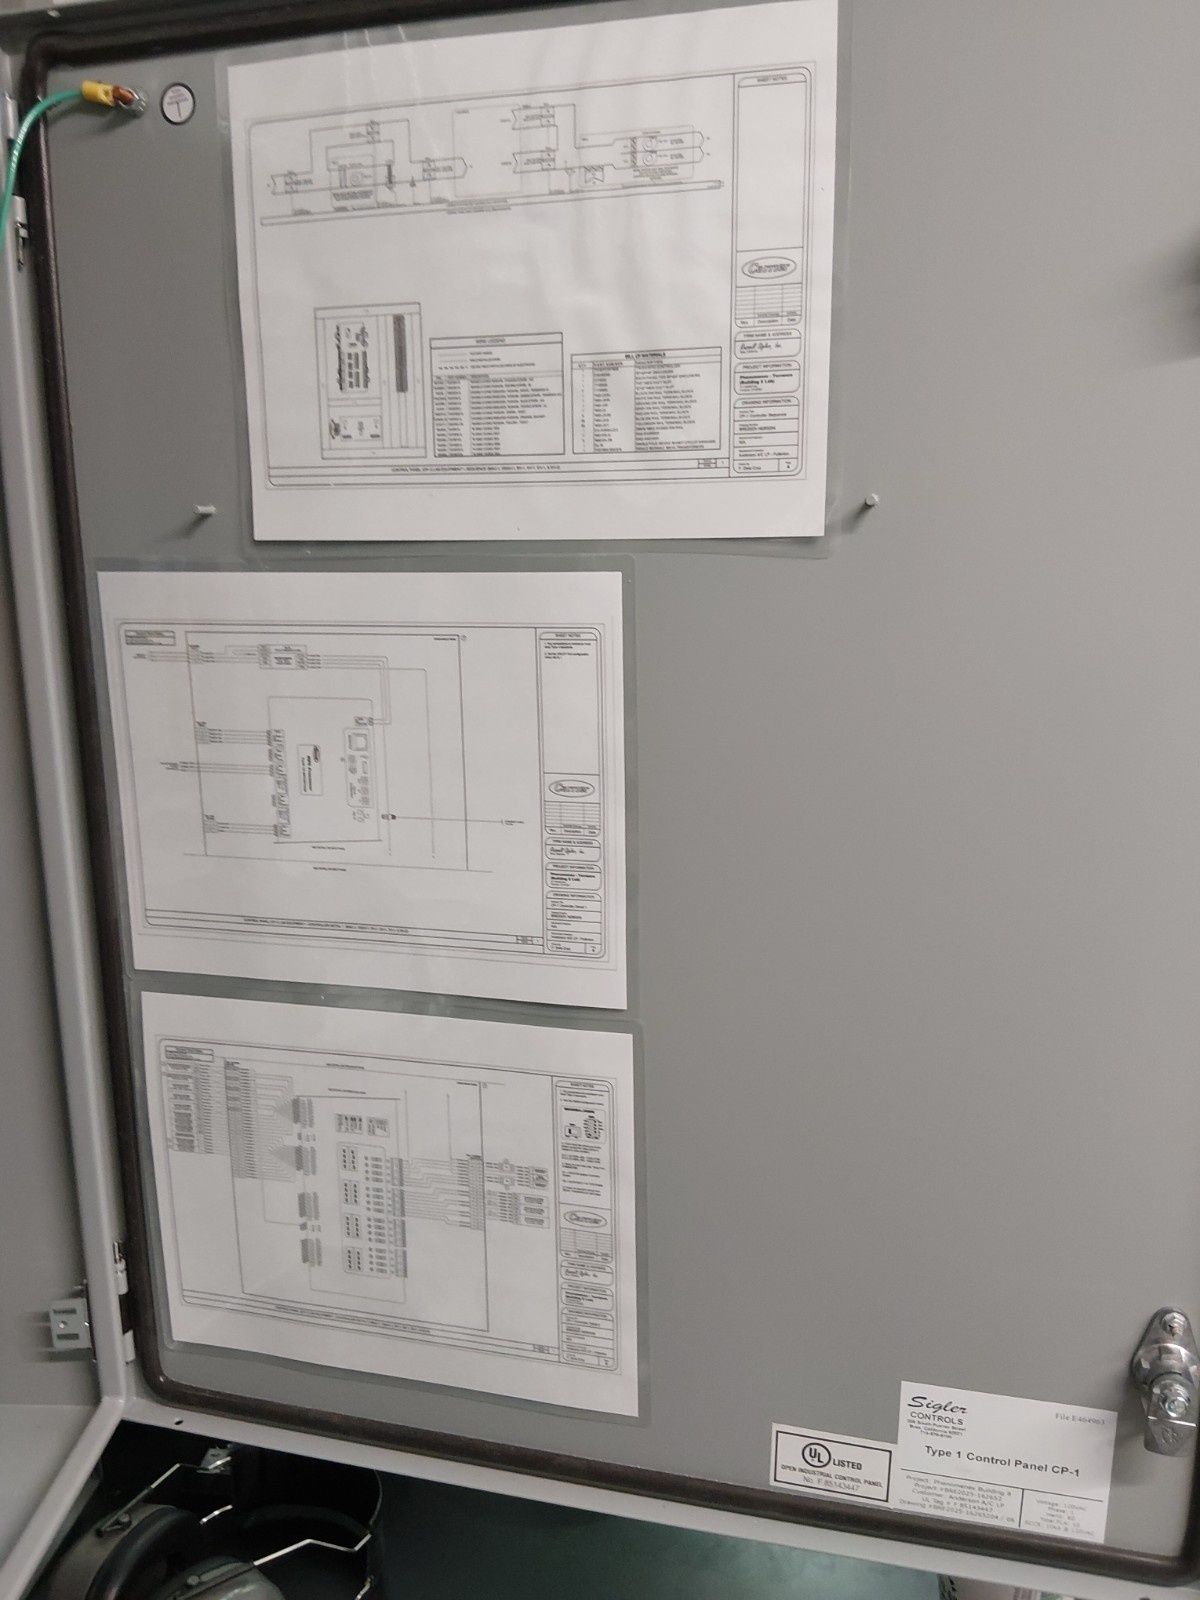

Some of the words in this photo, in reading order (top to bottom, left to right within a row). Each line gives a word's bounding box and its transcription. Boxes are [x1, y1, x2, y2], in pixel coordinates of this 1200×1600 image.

[910, 1411, 964, 1426] CONTROLS
[832, 1458, 863, 1471] LISTED
[925, 1445, 952, 1458] Type
[956, 1451, 962, 1459] 1
[966, 1452, 1011, 1467] Control
[1014, 1459, 1048, 1472] Panel
[1051, 1465, 1080, 1477] CP-1
[798, 1466, 833, 1479] INDUSTRIAL
[834, 1473, 863, 1485] CONTROL
